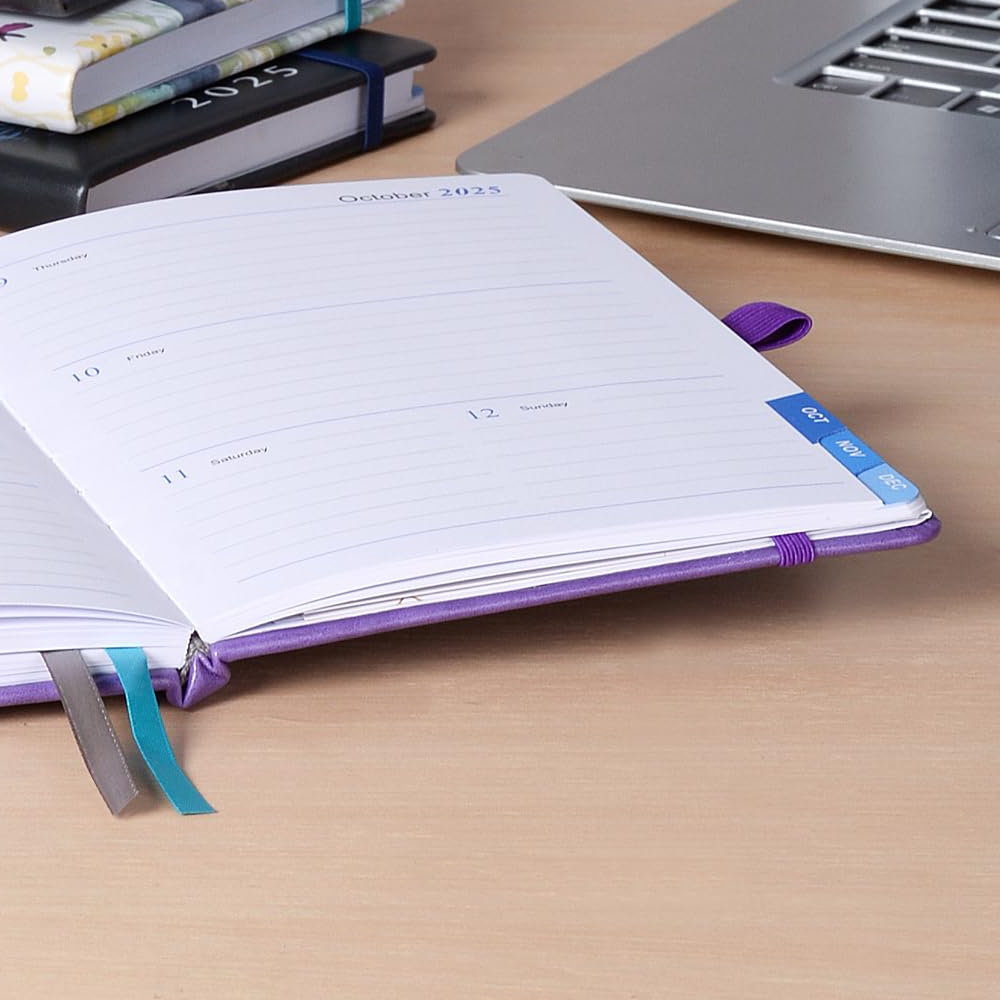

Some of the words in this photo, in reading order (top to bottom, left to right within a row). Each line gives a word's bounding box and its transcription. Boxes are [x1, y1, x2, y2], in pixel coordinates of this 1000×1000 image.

[171, 65, 299, 109] 2025
[338, 190, 431, 203] October
[438, 185, 502, 197] 2025
[32, 252, 89, 272] Thursday
[72, 366, 101, 383] 10
[126, 348, 166, 362] Friday
[467, 408, 500, 420] 12
[519, 402, 568, 412] Sunday
[801, 406, 830, 424] OCT
[835, 439, 867, 458] NOV
[162, 468, 188, 485] 11
[209, 446, 269, 466] Saturday
[878, 472, 907, 490] DEC
